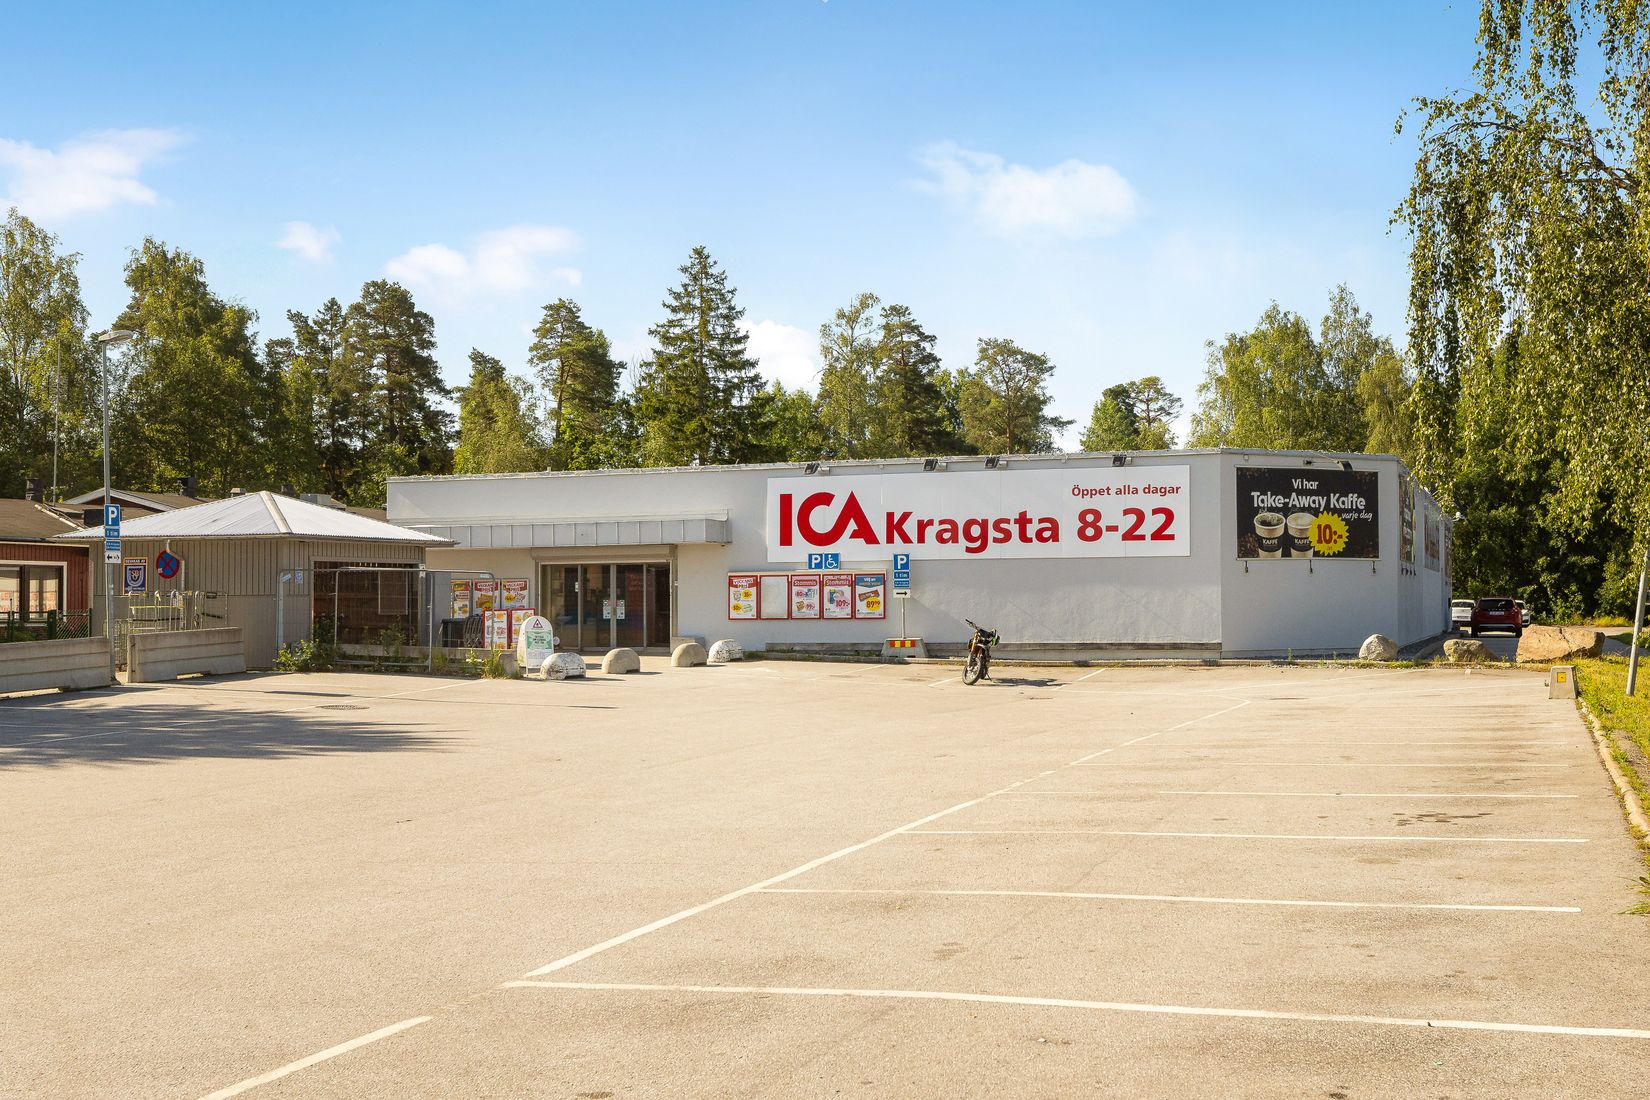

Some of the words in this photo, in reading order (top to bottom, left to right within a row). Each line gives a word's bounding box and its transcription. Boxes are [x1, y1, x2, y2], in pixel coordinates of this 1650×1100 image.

[1072, 485, 1111, 498] Öppet
[1115, 485, 1138, 496] alla
[1143, 484, 1181, 496] dagar
[1292, 479, 1301, 489] Vi
[1303, 479, 1318, 490] har
[1251, 491, 1327, 511] Take-Away
[1330, 493, 1365, 509] Kaffe
[108, 506, 117, 525] P
[779, 490, 880, 546] ICA
[886, 510, 1059, 553] Kragsta
[1360, 510, 1373, 521] dag
[1077, 507, 1175, 542] 8-22
[811, 555, 820, 568] P
[897, 555, 907, 569] P
